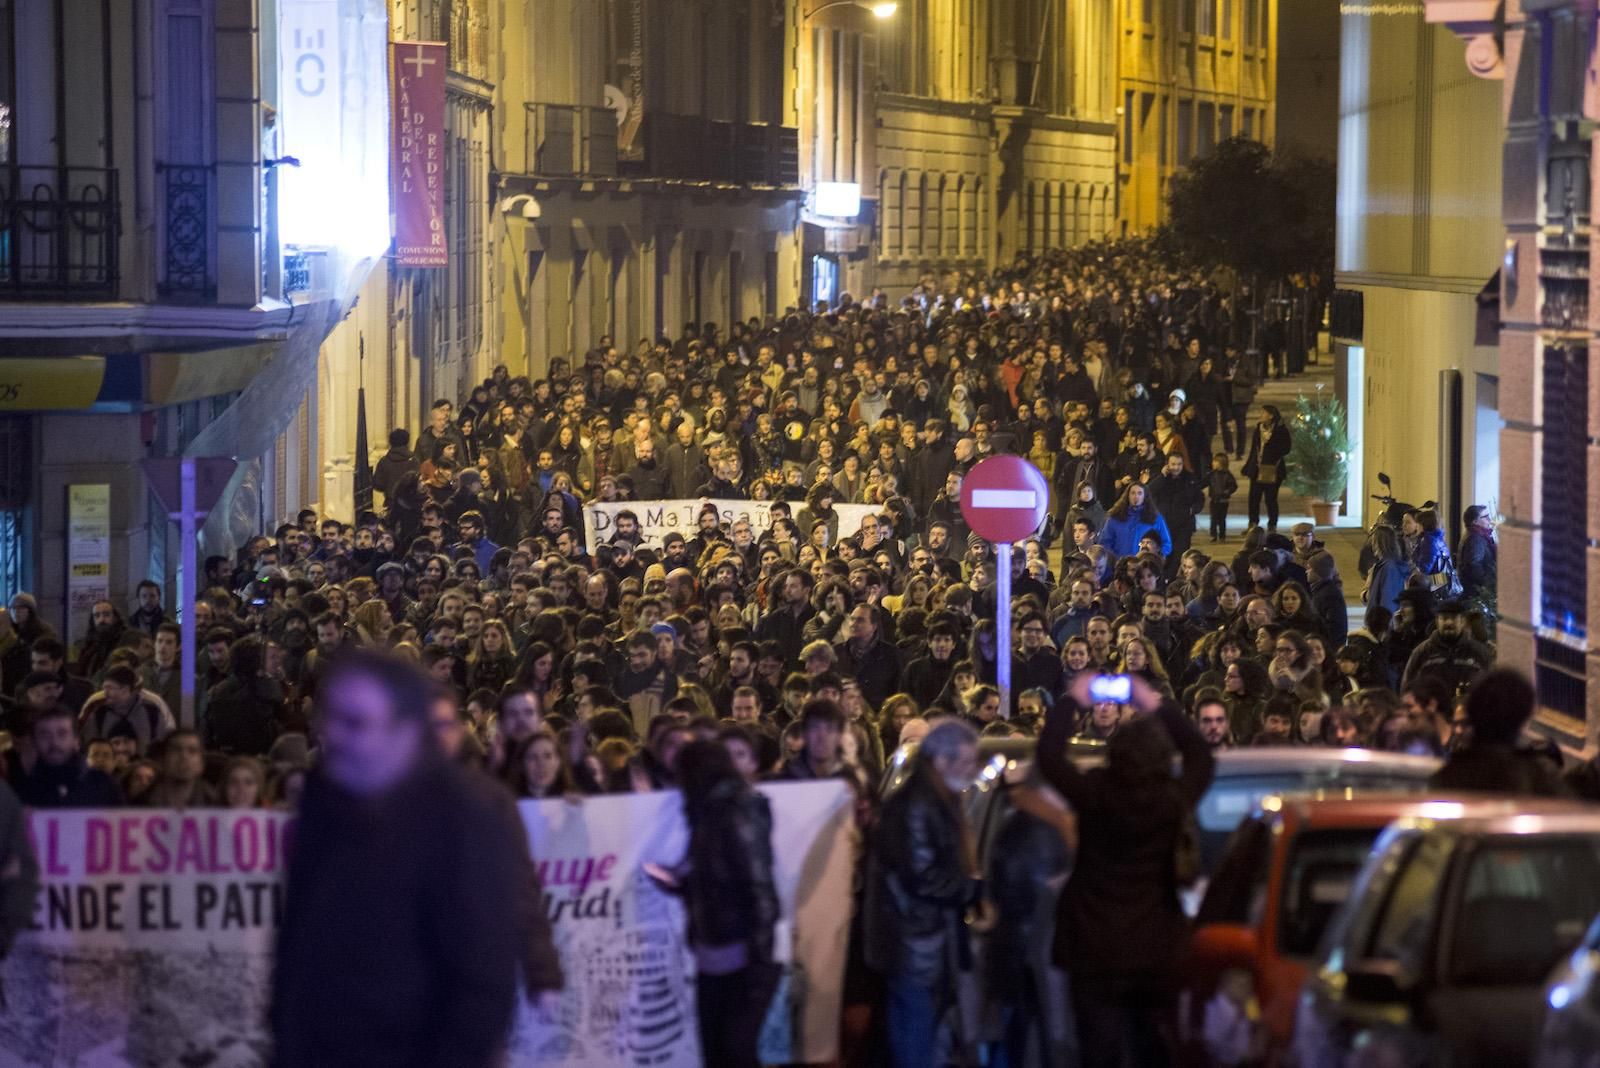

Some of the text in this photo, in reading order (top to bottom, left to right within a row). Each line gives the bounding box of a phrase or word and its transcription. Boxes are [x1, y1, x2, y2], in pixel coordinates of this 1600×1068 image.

[400, 77, 412, 193] CATEDRAL
[414, 113, 424, 154] DEL
[427, 134, 441, 245] REDENTOR
[139, 884, 181, 931] EL
[196, 883, 284, 931] PATI
